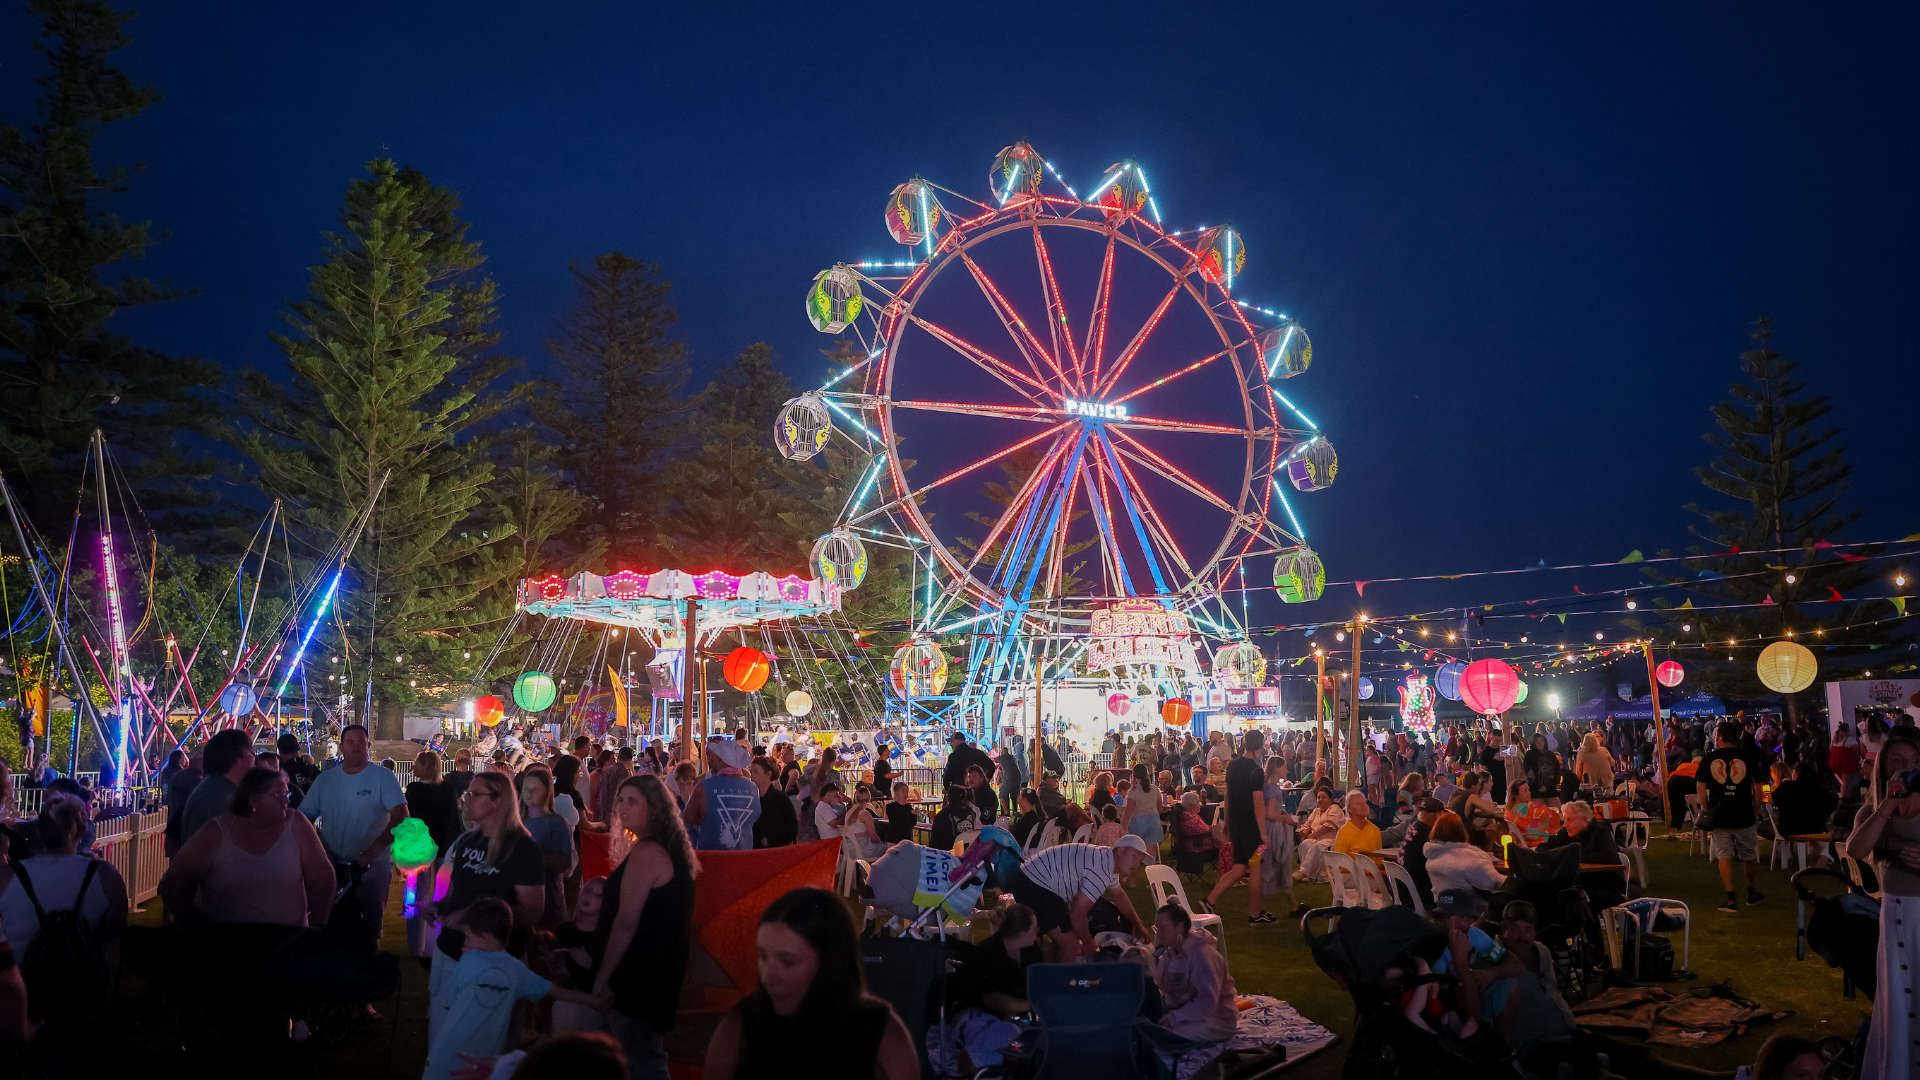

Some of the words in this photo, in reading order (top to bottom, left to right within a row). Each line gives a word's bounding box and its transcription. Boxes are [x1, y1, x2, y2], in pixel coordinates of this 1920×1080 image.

[1091, 608, 1190, 637] GRAND
[1086, 637, 1196, 675] WHEEL
[1226, 690, 1250, 704] TICKET
[1258, 690, 1276, 704] BOX
[1871, 690, 1901, 699] FESTIVAL
[462, 847, 485, 862] YOU
